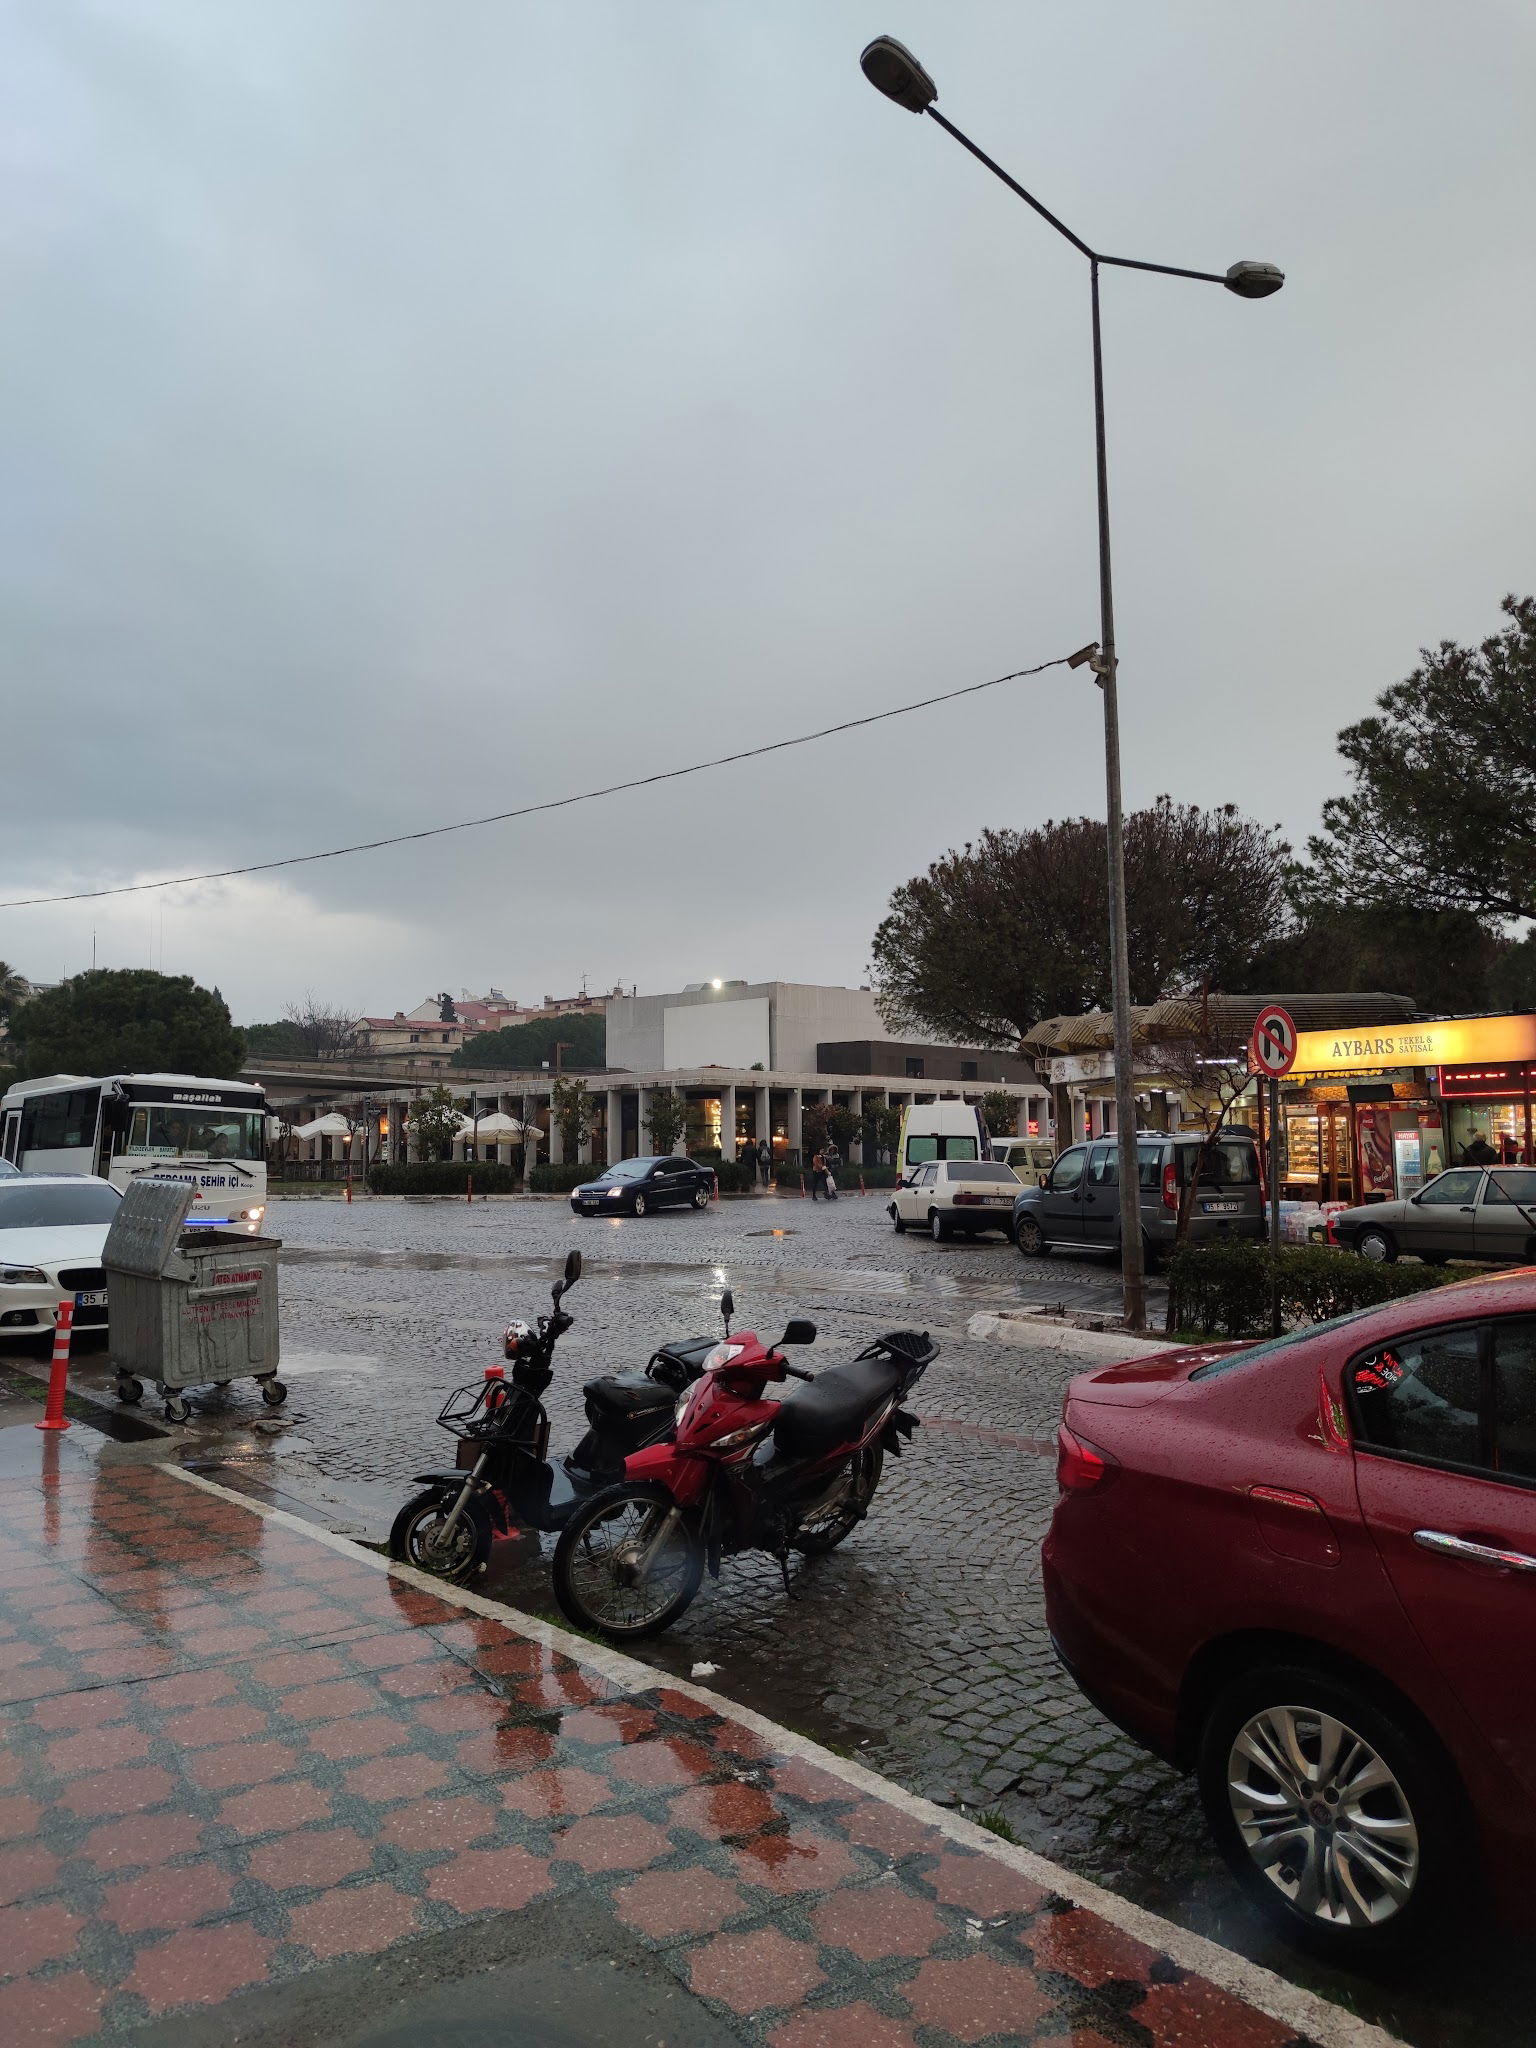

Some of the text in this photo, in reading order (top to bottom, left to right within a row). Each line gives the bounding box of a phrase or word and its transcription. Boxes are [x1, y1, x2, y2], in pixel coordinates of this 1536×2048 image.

[1398, 1035, 1433, 1045] TEKEL &
[1332, 1038, 1395, 1057] AYBARS
[1398, 1044, 1433, 1054] SAYISAL
[172, 1093, 222, 1103] maşallah
[200, 1174, 226, 1188] ŞEHİR
[228, 1174, 239, 1189] İÇİ
[83, 1294, 96, 1304] 35
